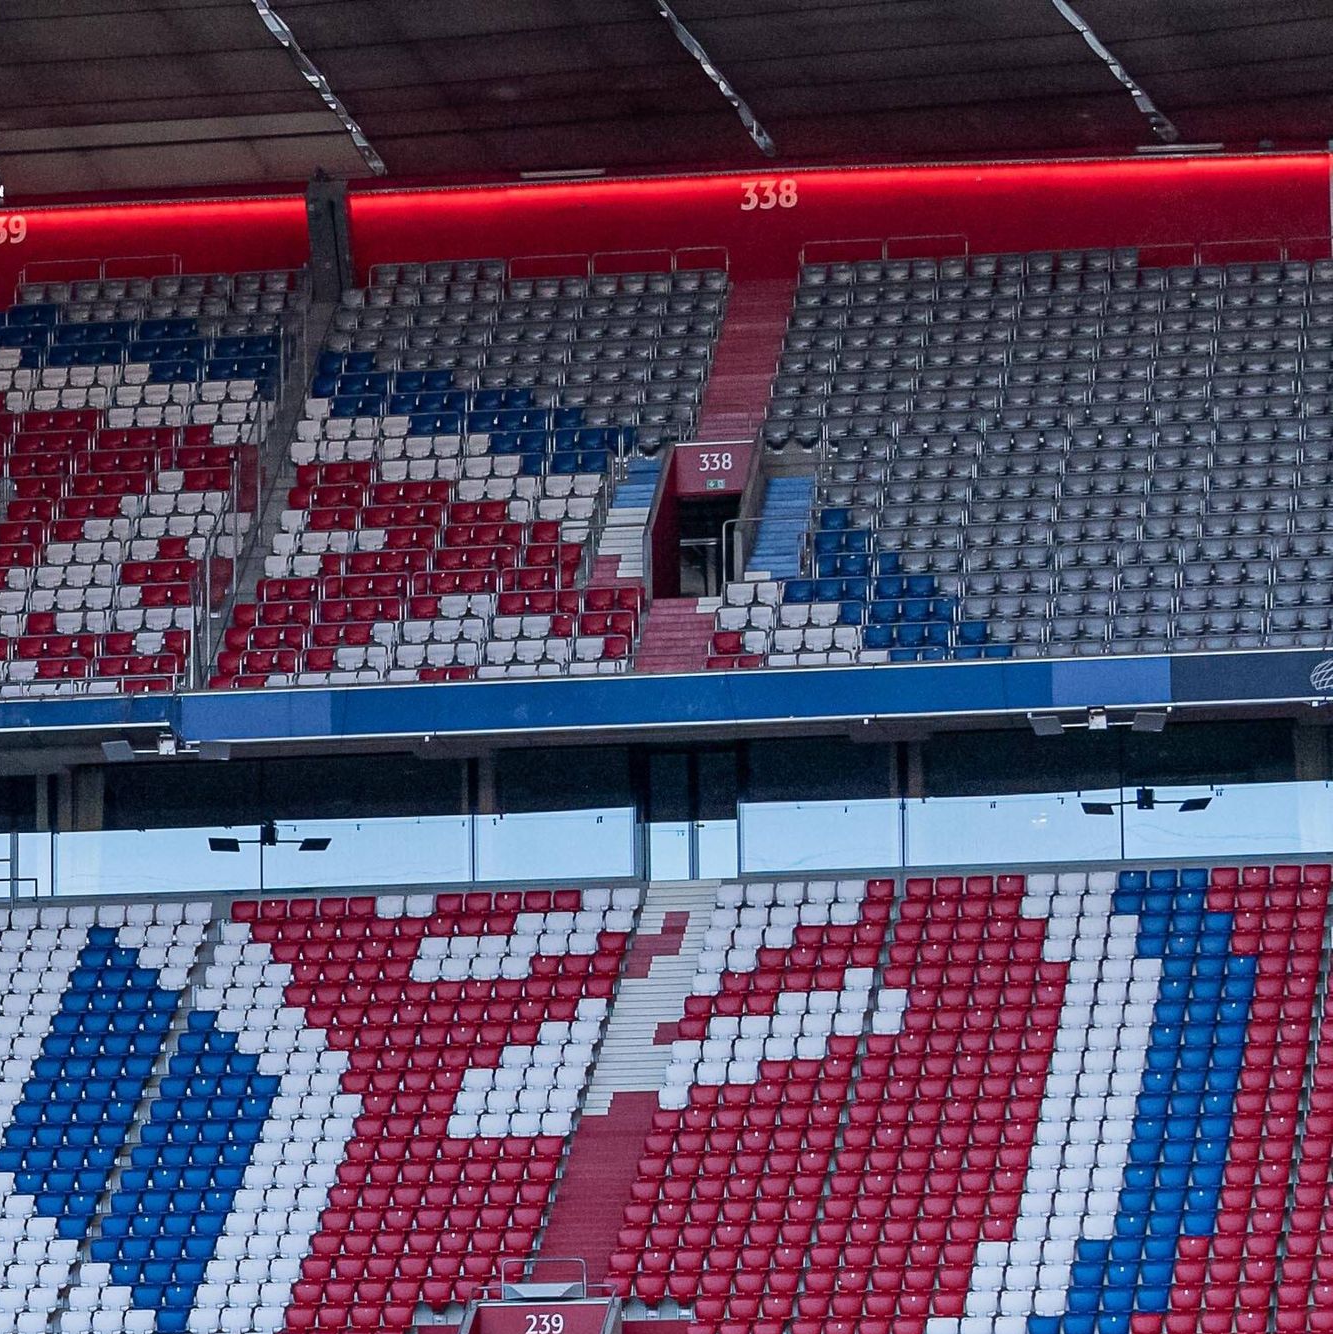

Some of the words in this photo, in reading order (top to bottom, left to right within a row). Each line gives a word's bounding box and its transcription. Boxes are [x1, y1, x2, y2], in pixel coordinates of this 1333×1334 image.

[741, 179, 797, 210] 338
[699, 453, 732, 471] 338
[526, 1314, 563, 1334] 239
